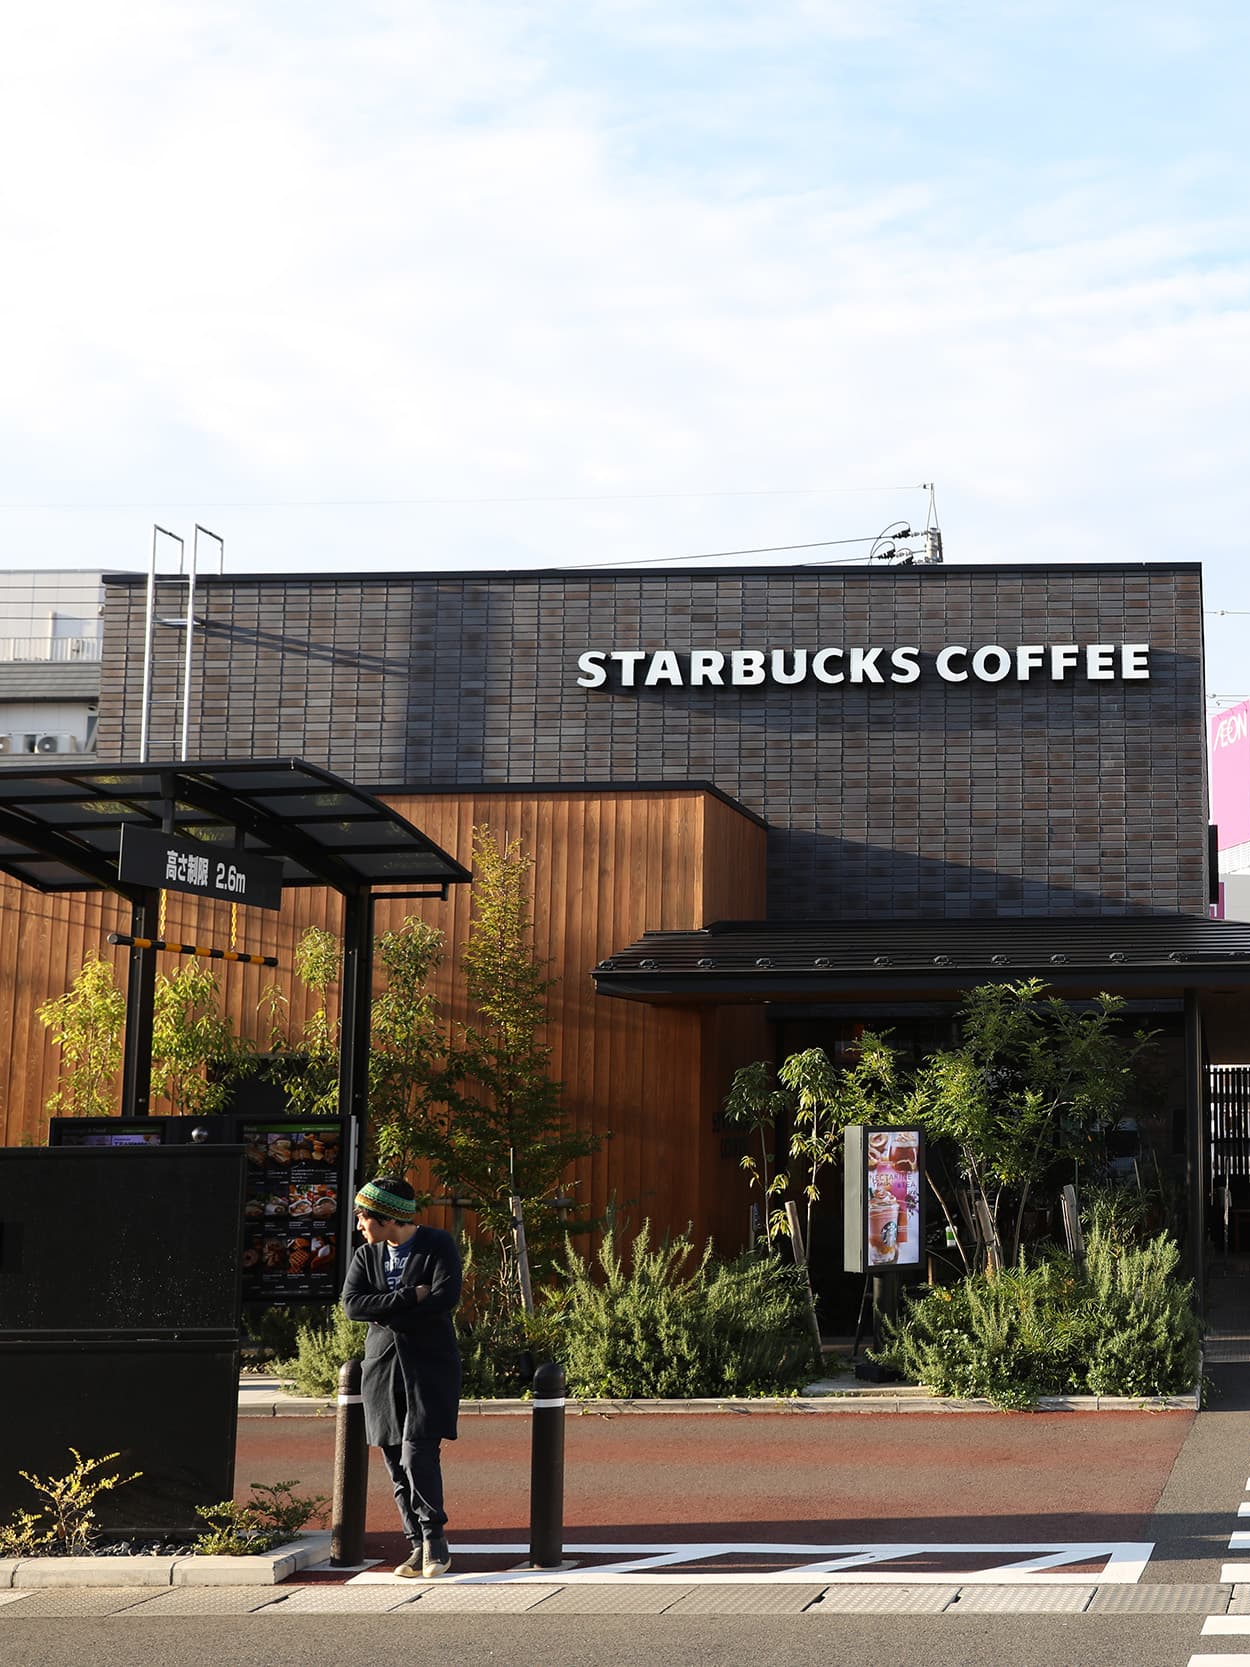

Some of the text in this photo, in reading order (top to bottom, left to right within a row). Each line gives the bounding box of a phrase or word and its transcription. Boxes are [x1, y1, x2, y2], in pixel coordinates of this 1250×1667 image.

[577, 644, 1151, 688] STARBUCKS COFFEE
[165, 850, 246, 894] 高さ制限 2.6m
